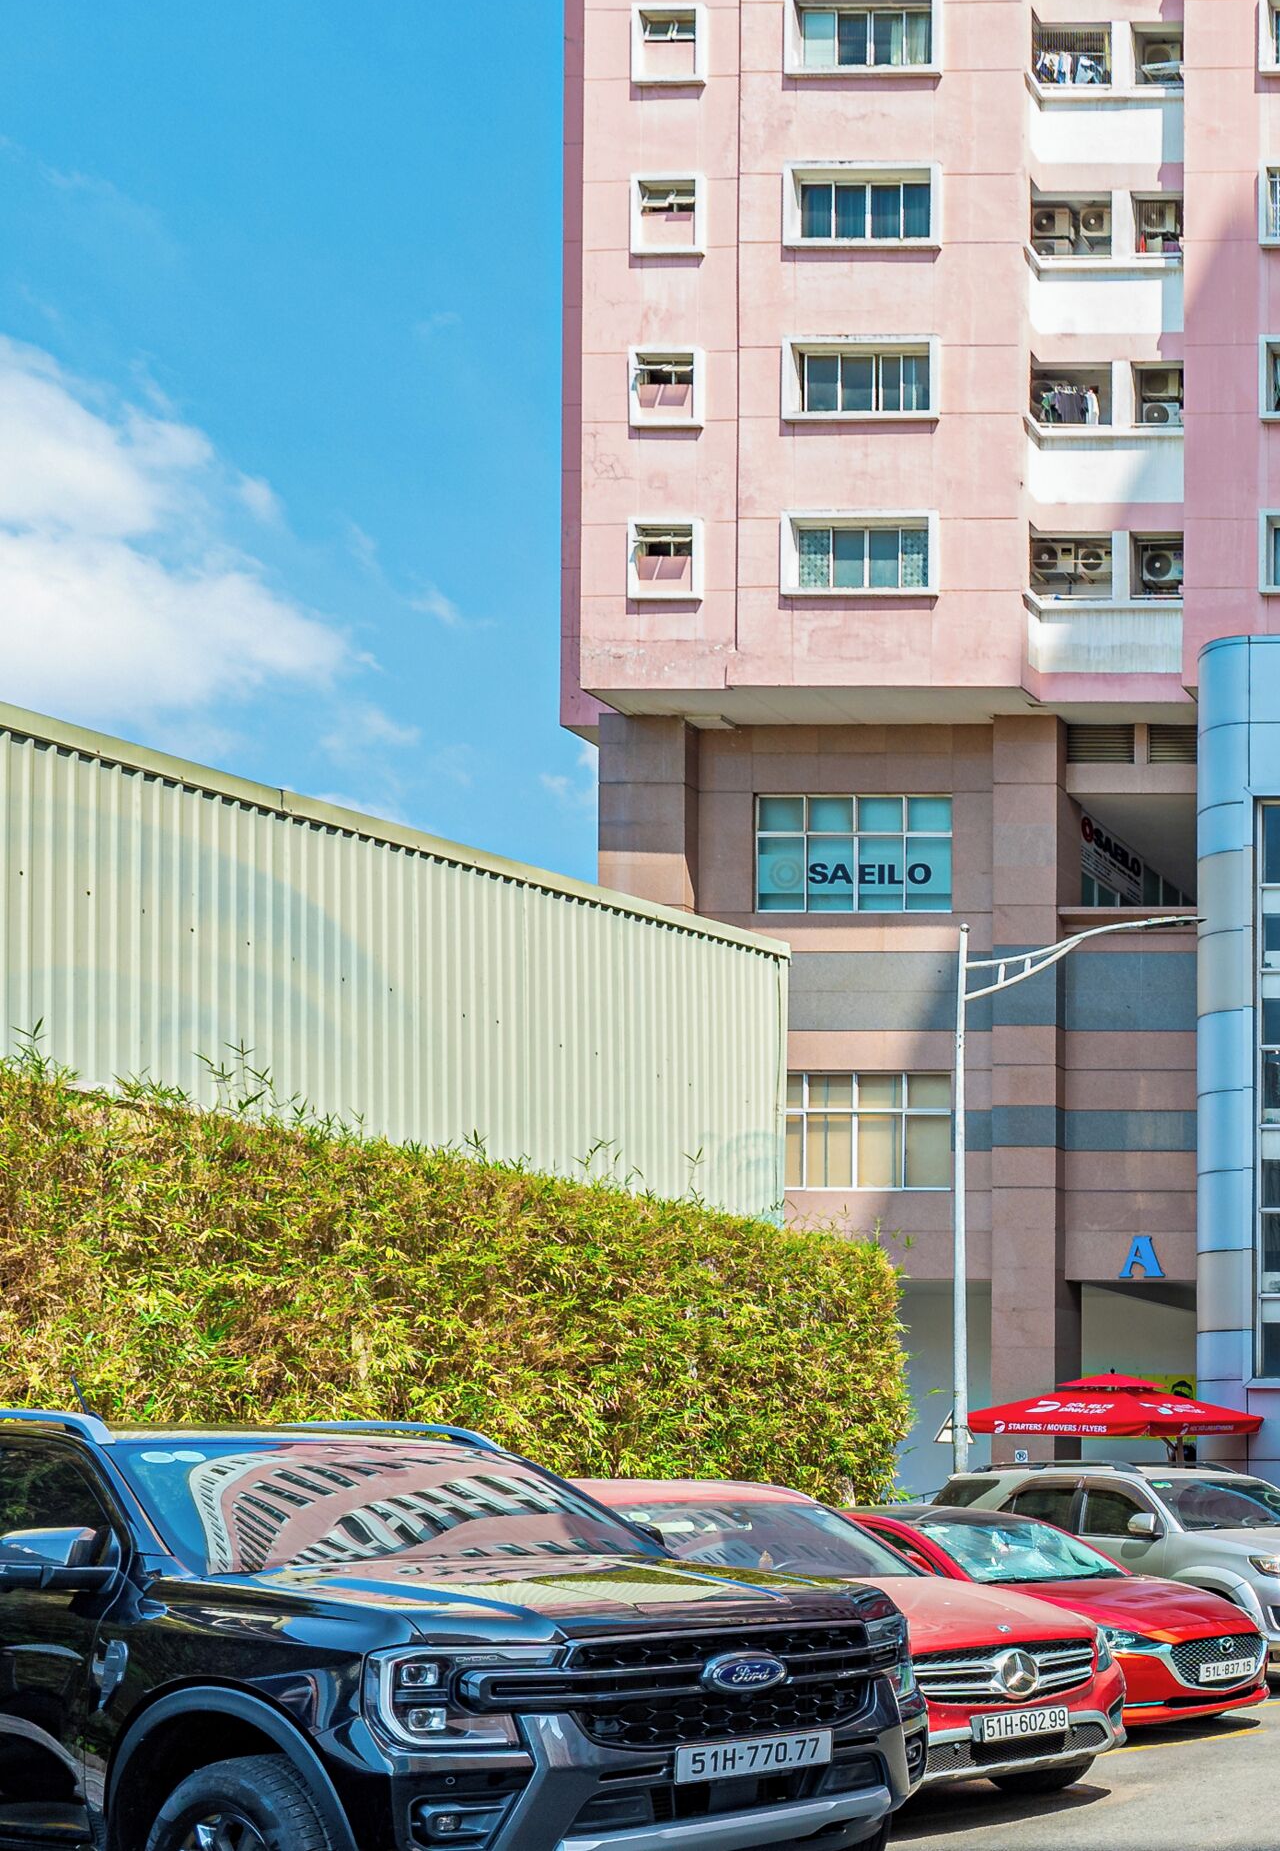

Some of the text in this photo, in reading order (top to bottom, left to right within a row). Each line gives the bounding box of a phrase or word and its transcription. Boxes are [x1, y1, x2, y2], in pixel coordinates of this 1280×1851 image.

[808, 863, 932, 885] SAEILO
[1119, 1236, 1166, 1278] A
[1008, 1423, 1042, 1431] STARTERS
[1046, 1424, 1077, 1432] MOVERS
[1082, 1425, 1107, 1433] FLYERS
[732, 1664, 771, 1683] Ford
[1205, 1660, 1252, 1678] 51L-837.15
[986, 1709, 1067, 1738] 51H-602.99
[691, 1737, 820, 1775] 51H-770.77
